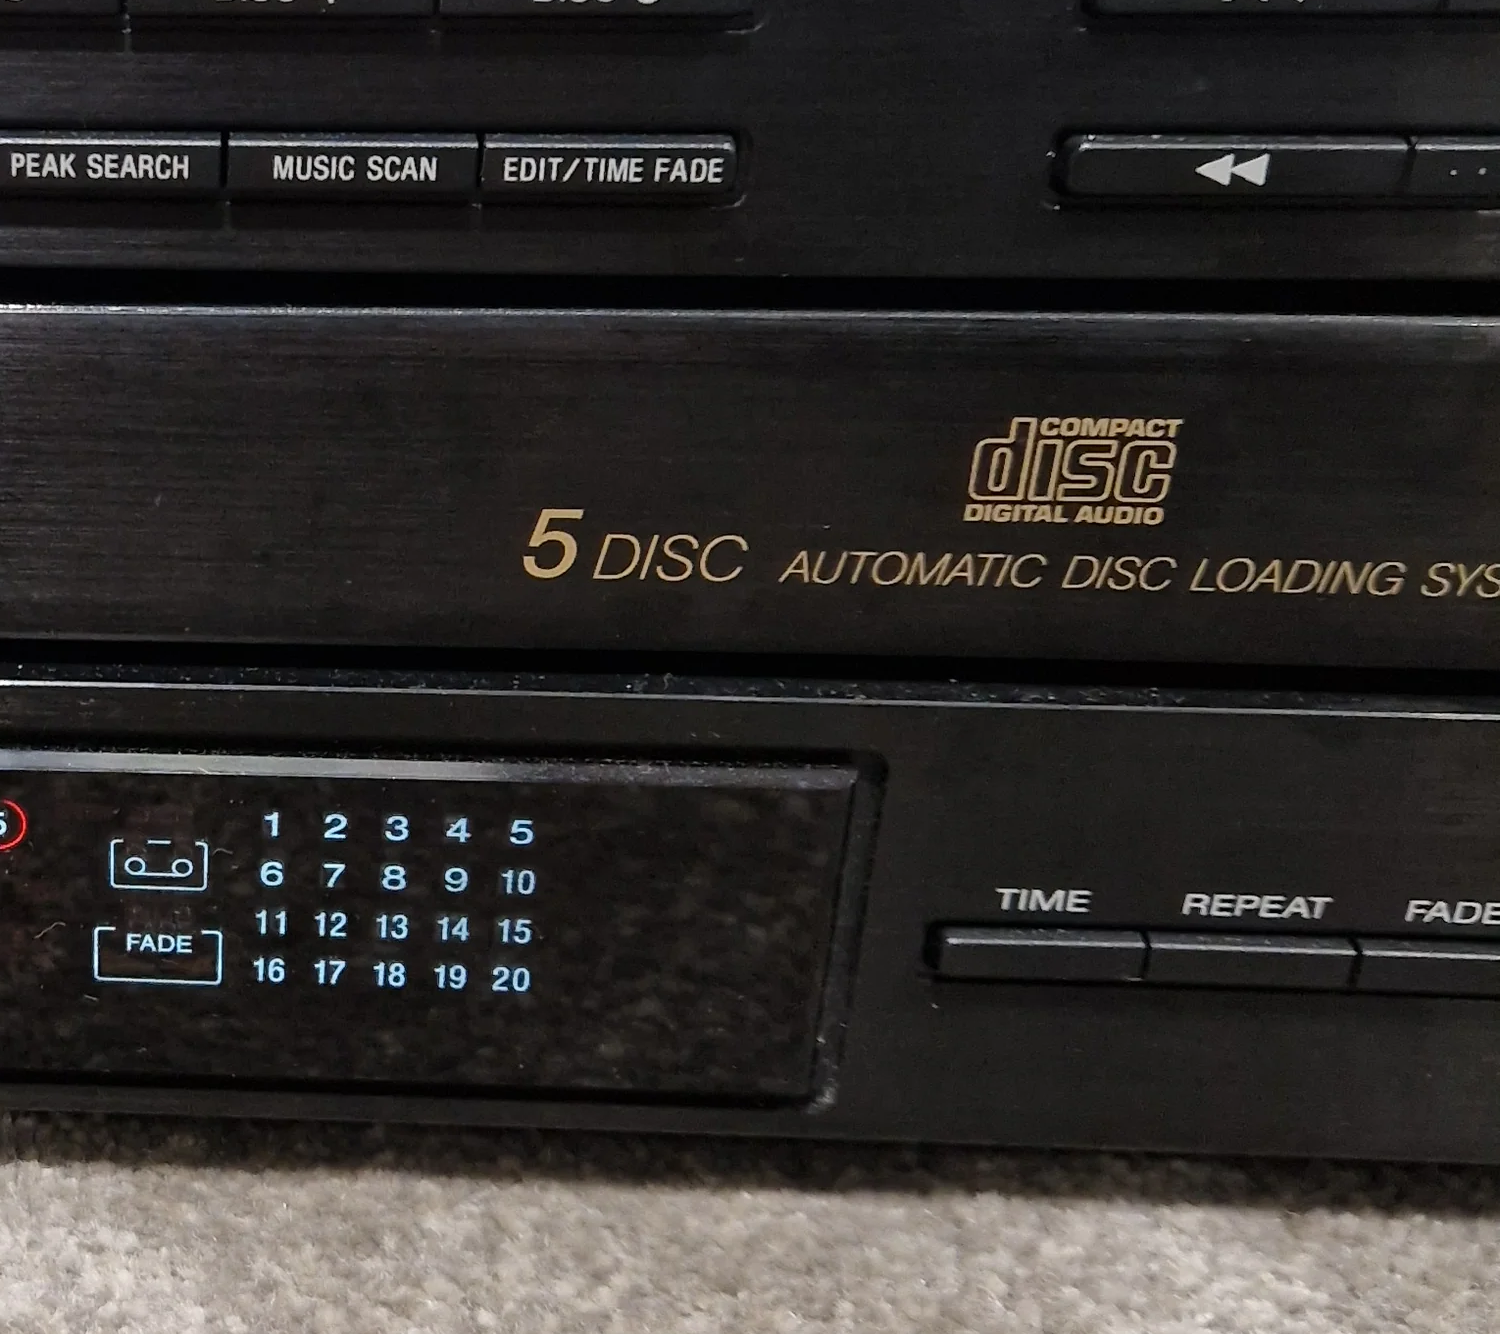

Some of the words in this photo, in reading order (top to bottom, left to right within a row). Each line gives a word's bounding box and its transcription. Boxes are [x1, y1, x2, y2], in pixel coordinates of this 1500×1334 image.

[10, 152, 76, 178] PEAK
[86, 153, 189, 180] SEARCH
[273, 154, 355, 181] MUSIC
[366, 155, 438, 182] SCAN
[653, 157, 724, 183] FADE
[1039, 417, 1184, 438] COMPACT
[962, 503, 1069, 523] DIGITAL
[1073, 505, 1165, 526] AUDIO
[522, 508, 585, 579] 5
[592, 533, 749, 582] DISC
[778, 550, 1045, 589] AUTOMATIC
[1061, 555, 1178, 591] DISC
[1189, 557, 1407, 596] LOADING
[1420, 562, 1500, 598] SYS
[263, 811, 279, 837] 1
[323, 813, 348, 839] 2
[384, 815, 409, 842] 3
[445, 817, 472, 843] 4
[509, 819, 534, 845] 5
[260, 861, 284, 887] 6
[323, 863, 346, 888] 7
[381, 865, 407, 891] 8
[444, 867, 469, 893] 9
[501, 869, 536, 895] 10
[995, 887, 1093, 913] TIME
[1181, 893, 1334, 920] REPEAT
[1404, 899, 1500, 925] FADE
[255, 909, 287, 935] 11
[314, 911, 347, 937] 12
[376, 914, 409, 940] 13
[437, 916, 470, 942] 14
[497, 918, 532, 944] 15
[126, 932, 193, 954] FADE
[253, 956, 285, 983] 16
[313, 959, 346, 985] 17
[373, 961, 406, 988] 18
[433, 964, 467, 990] 19
[491, 966, 531, 992] 20
